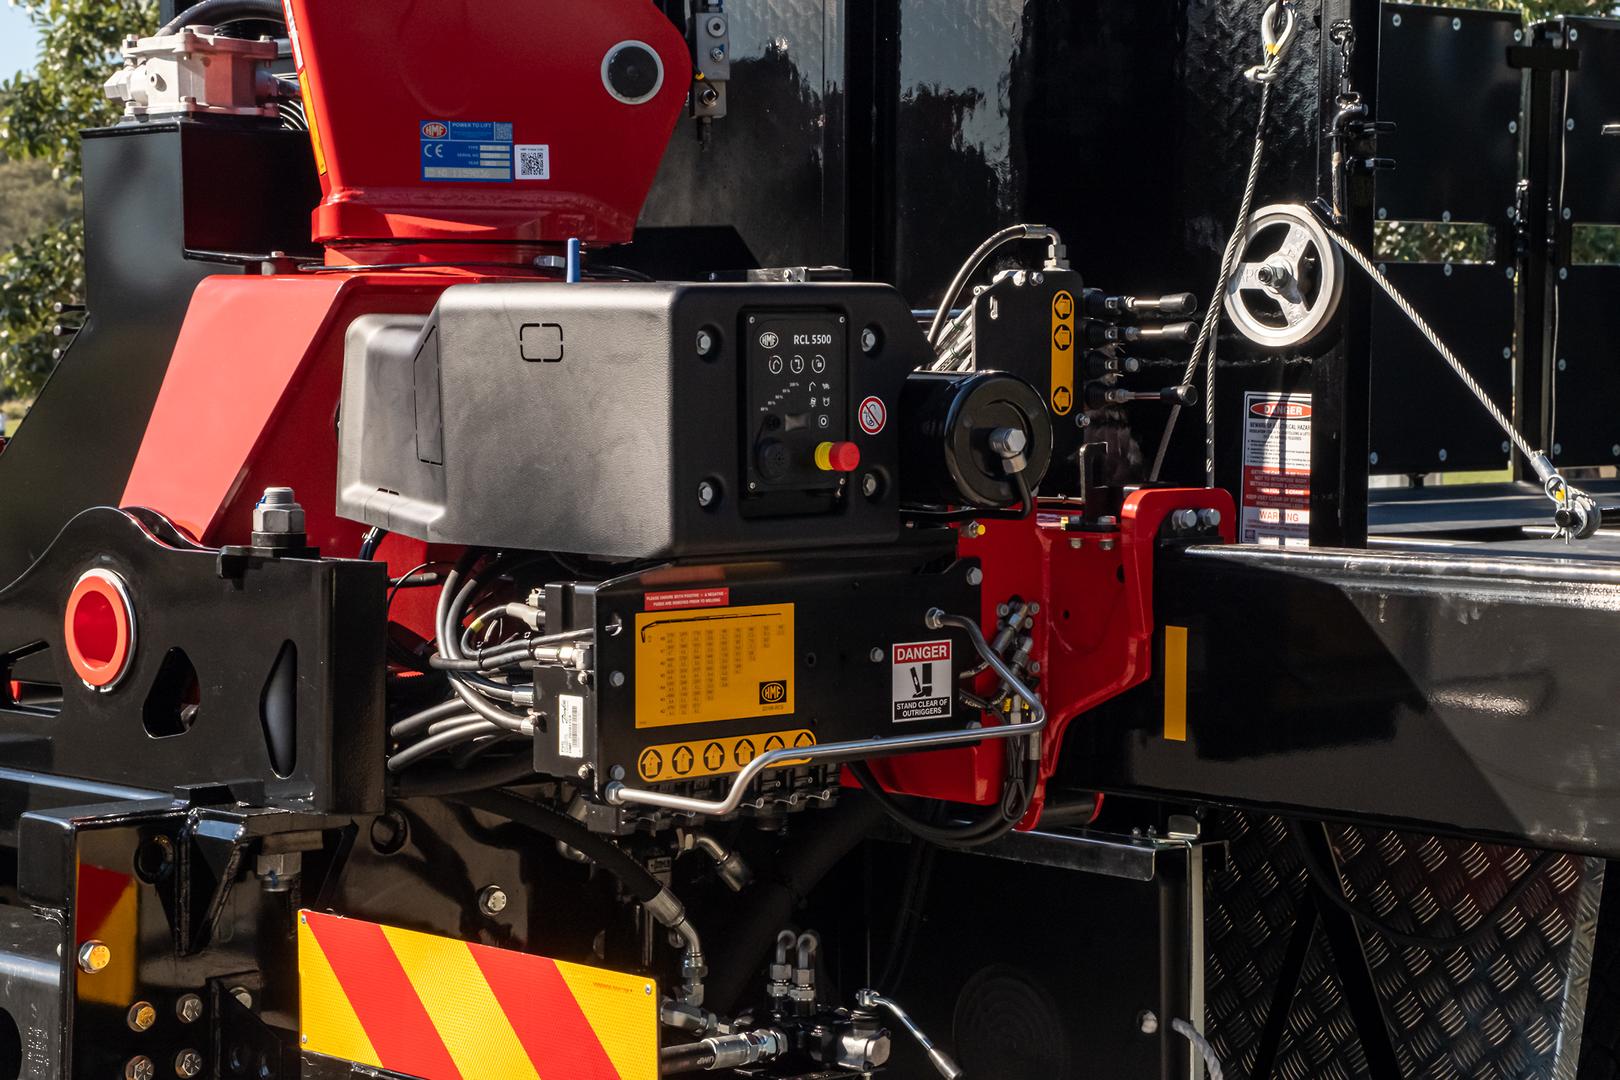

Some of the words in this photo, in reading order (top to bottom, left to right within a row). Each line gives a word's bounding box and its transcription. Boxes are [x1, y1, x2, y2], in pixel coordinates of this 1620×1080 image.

[793, 335, 810, 345] RCL
[812, 334, 832, 344] 5500
[1264, 405, 1303, 416] DANGER
[897, 645, 947, 660] DANGER
[765, 685, 781, 699] HMF
[896, 701, 917, 710] STAND
[918, 700, 938, 709] CLEAR
[902, 707, 942, 717] OUTRIGGERS
